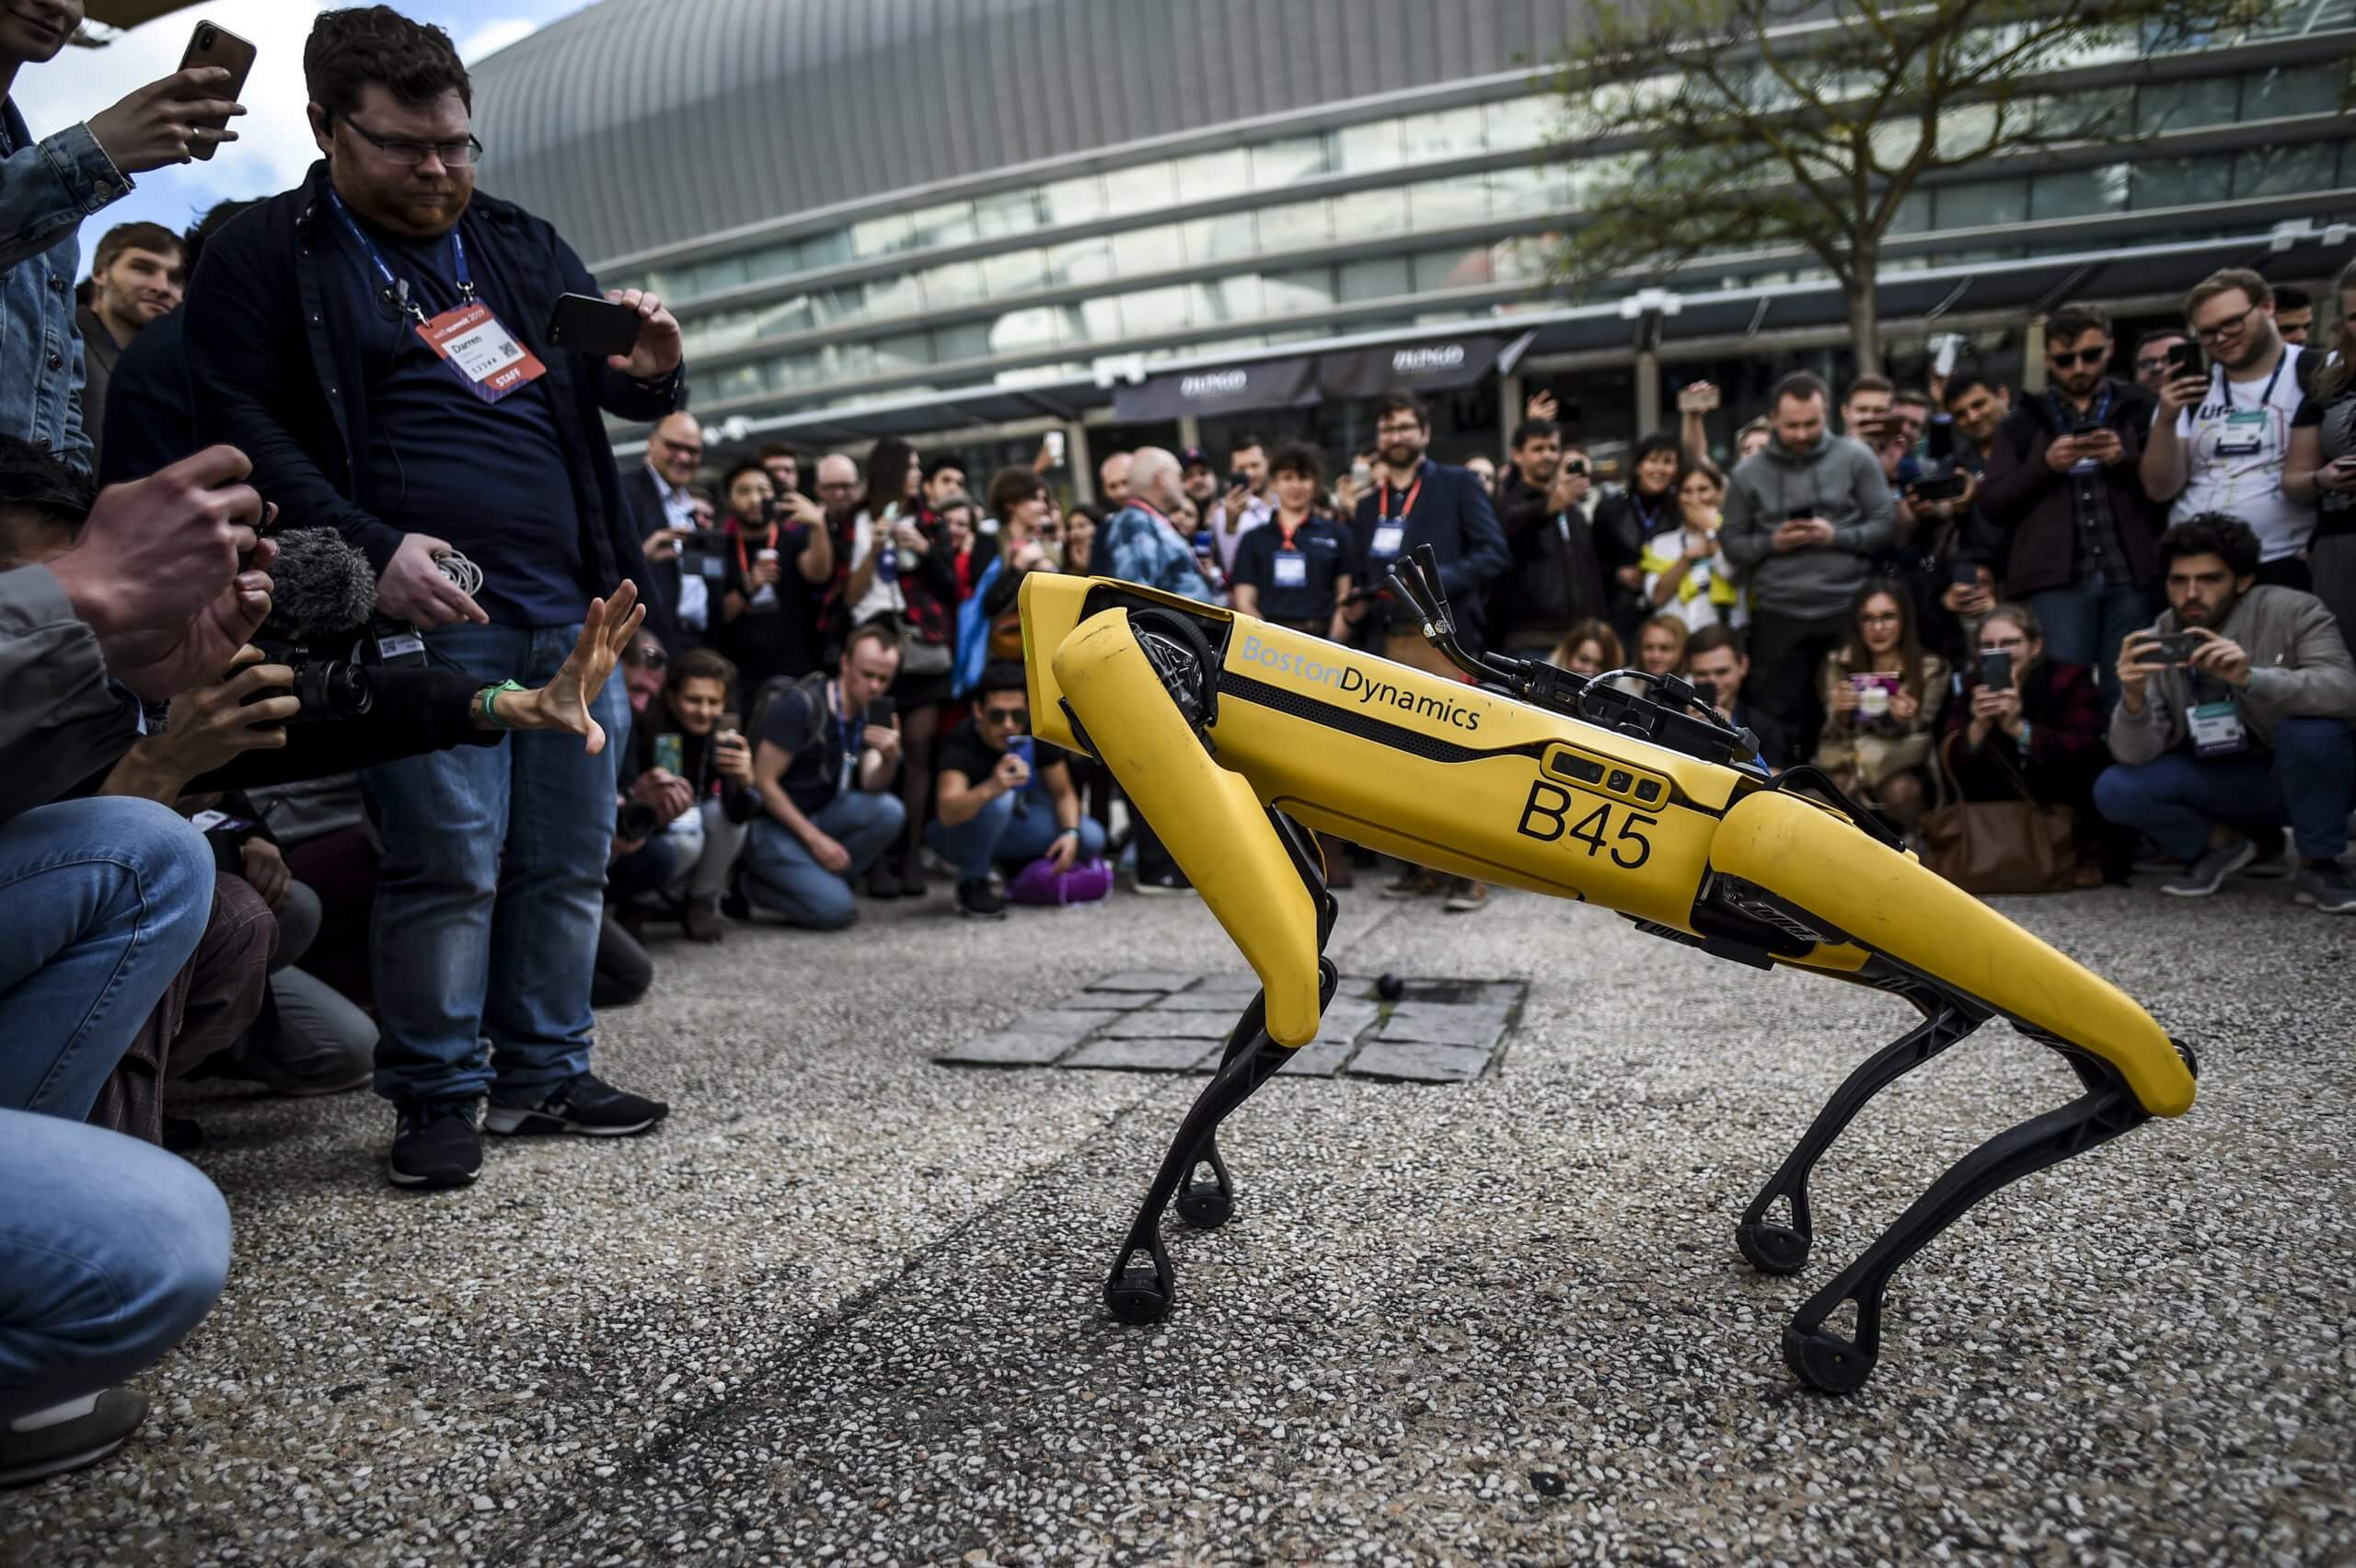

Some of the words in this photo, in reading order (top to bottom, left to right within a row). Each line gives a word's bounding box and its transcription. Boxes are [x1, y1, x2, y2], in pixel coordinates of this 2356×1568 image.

[452, 336, 483, 354] Darren
[495, 367, 522, 387] STAFF
[1517, 779, 1657, 870] B45
